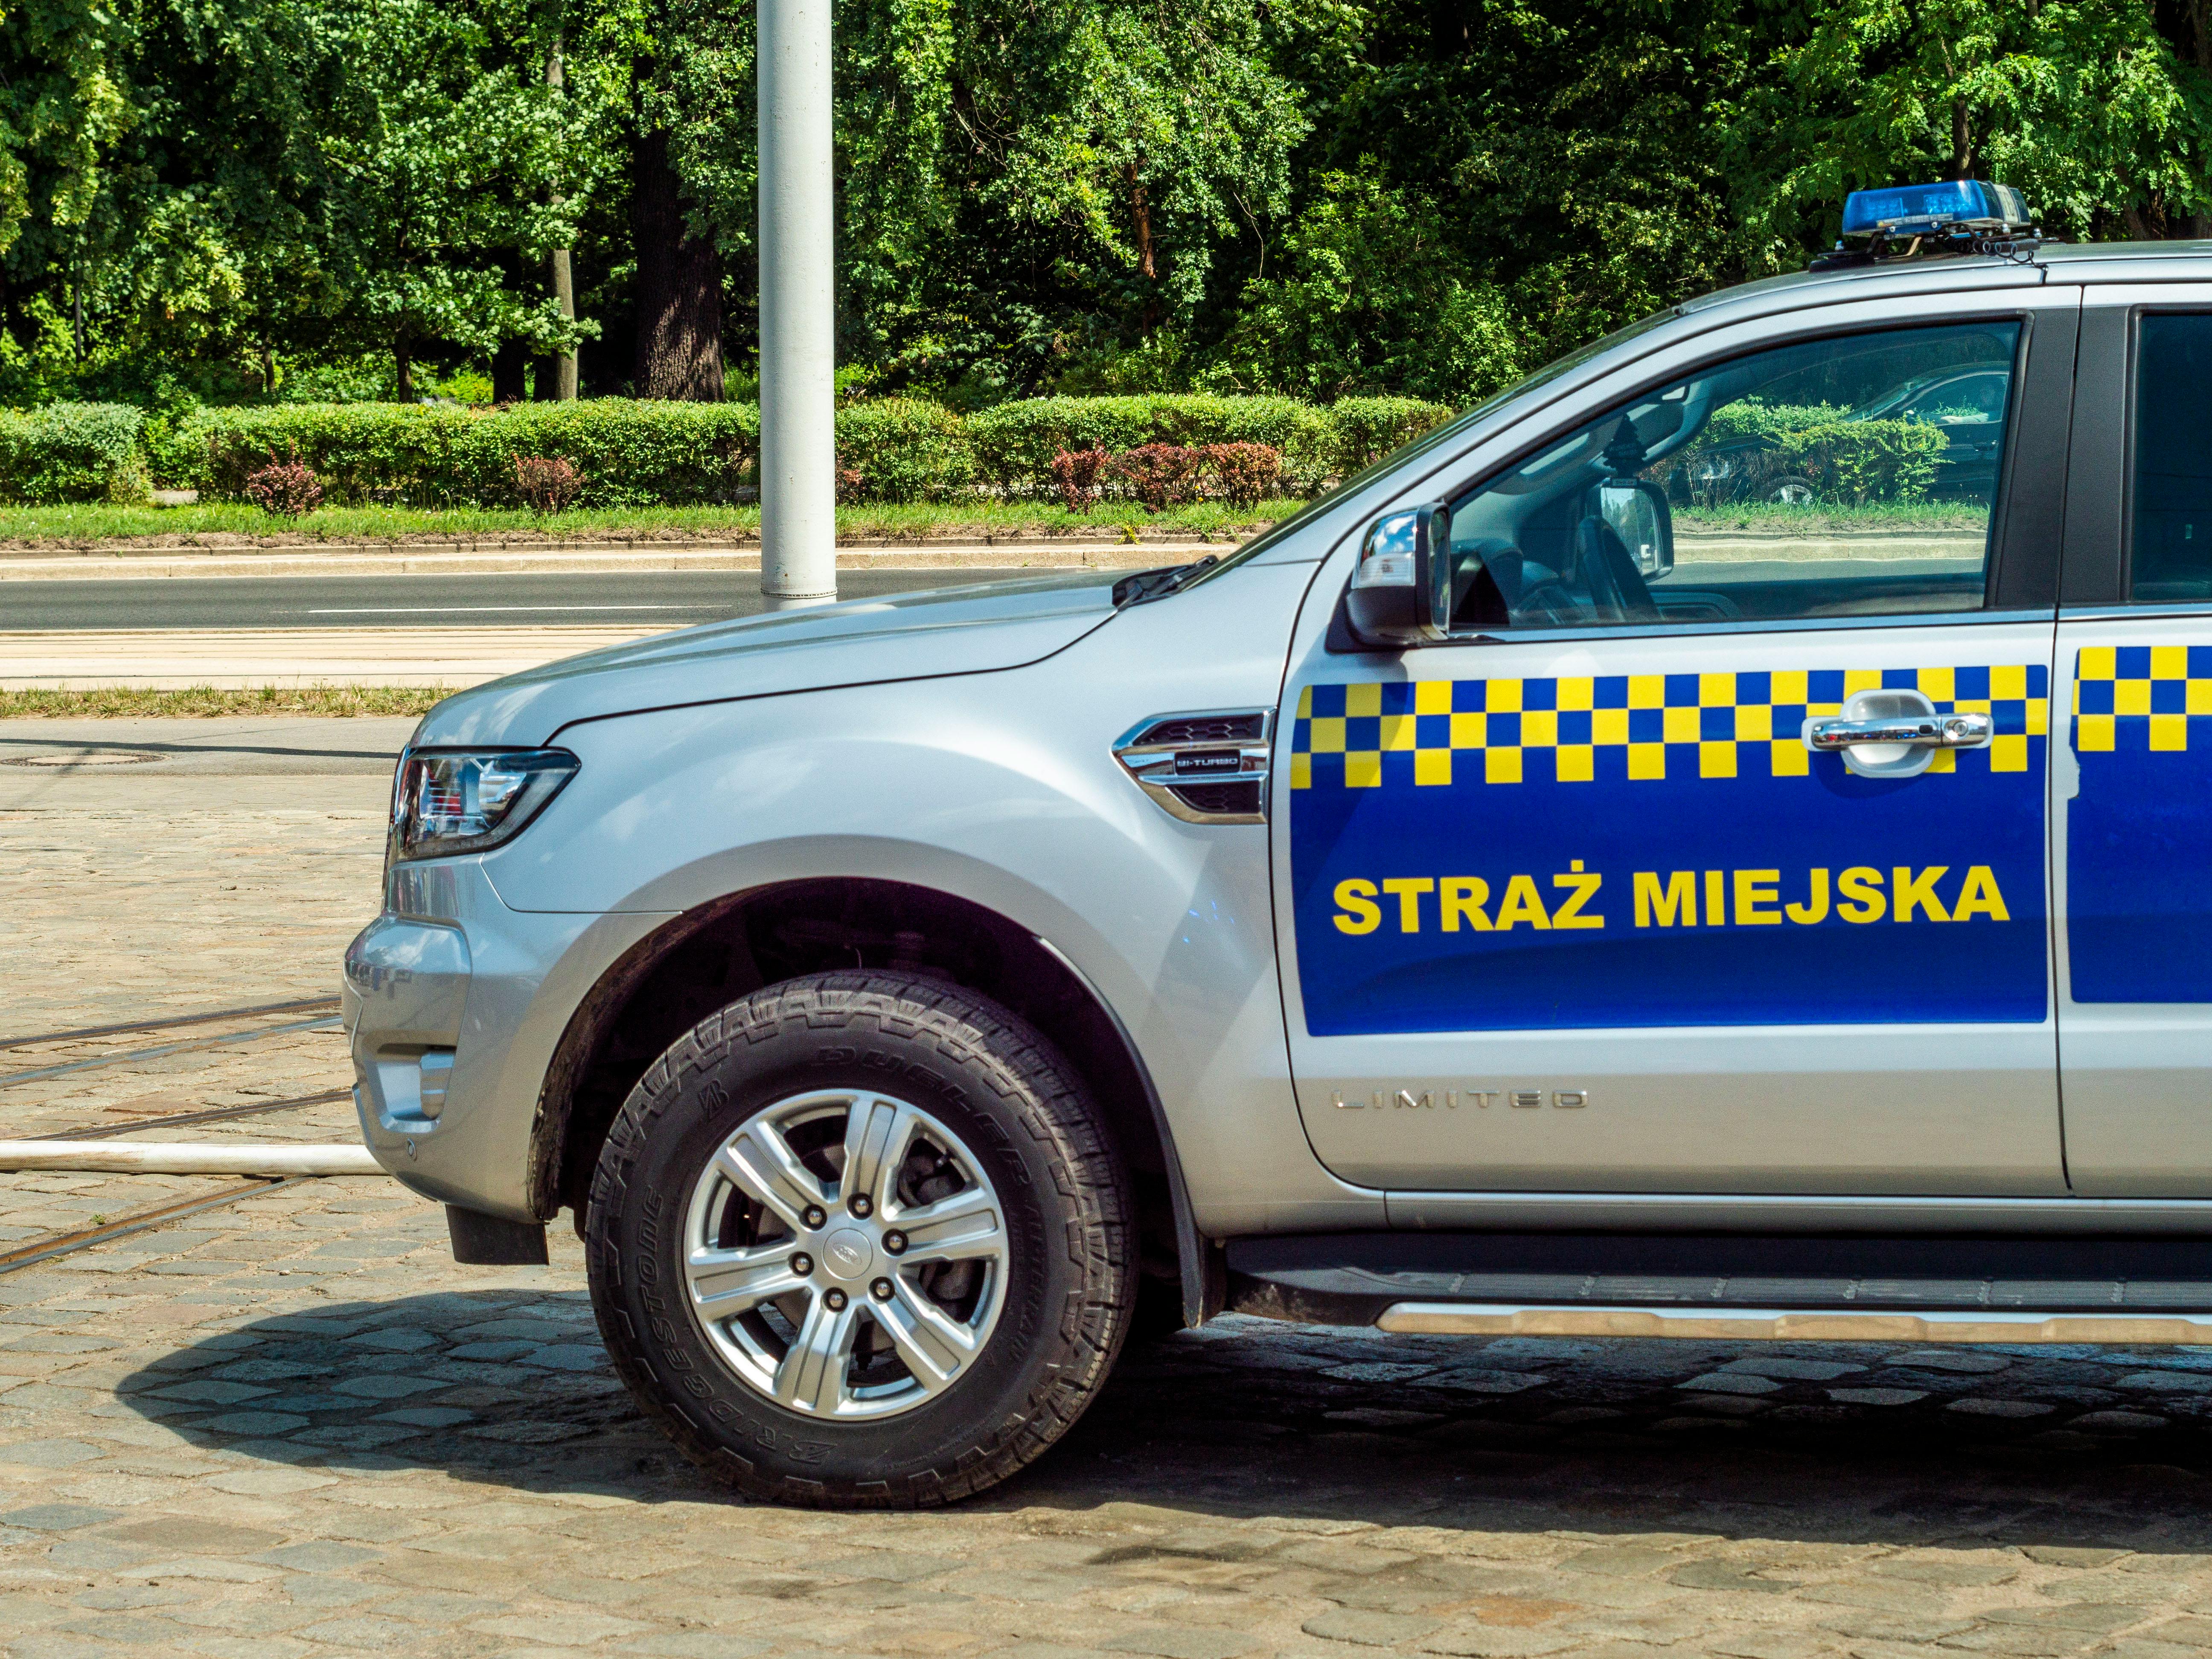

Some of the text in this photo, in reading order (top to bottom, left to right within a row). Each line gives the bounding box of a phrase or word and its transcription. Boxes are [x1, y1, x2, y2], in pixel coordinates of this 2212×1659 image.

[1177, 757, 1238, 767] BI-TURBO
[1334, 860, 2009, 934] STRAŻ MIEJSKA
[1331, 1089, 1588, 1109] LIMITED
[636, 1184, 839, 1464] BRIDGESTONE
